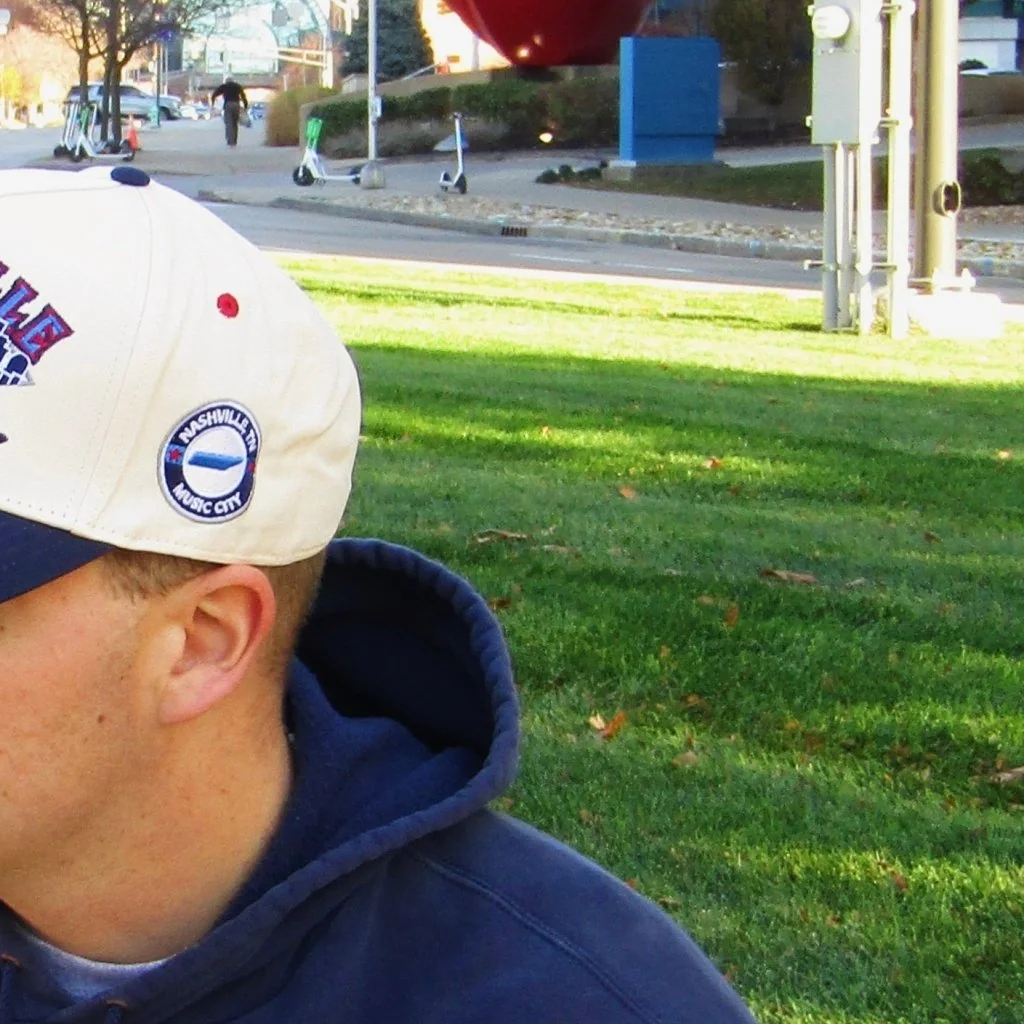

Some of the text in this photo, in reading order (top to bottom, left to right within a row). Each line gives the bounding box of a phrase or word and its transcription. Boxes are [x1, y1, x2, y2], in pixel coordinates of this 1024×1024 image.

[245, 429, 257, 453] TN
[172, 482, 242, 514] MUSIC CITY
